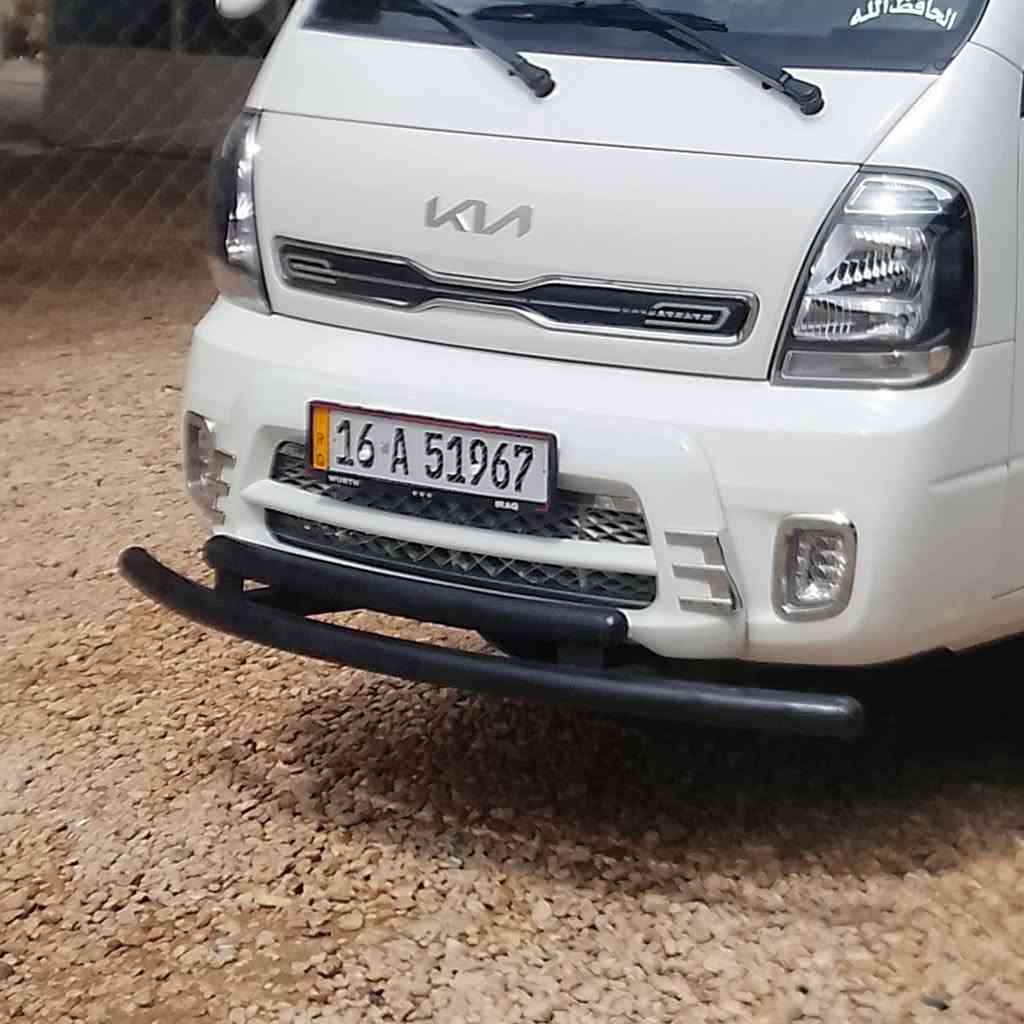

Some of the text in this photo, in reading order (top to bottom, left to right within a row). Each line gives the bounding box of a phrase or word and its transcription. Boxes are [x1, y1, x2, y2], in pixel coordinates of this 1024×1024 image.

[424, 196, 535, 238] KIA
[335, 419, 376, 468] 16
[391, 427, 409, 476] A
[424, 431, 534, 493] 51967
